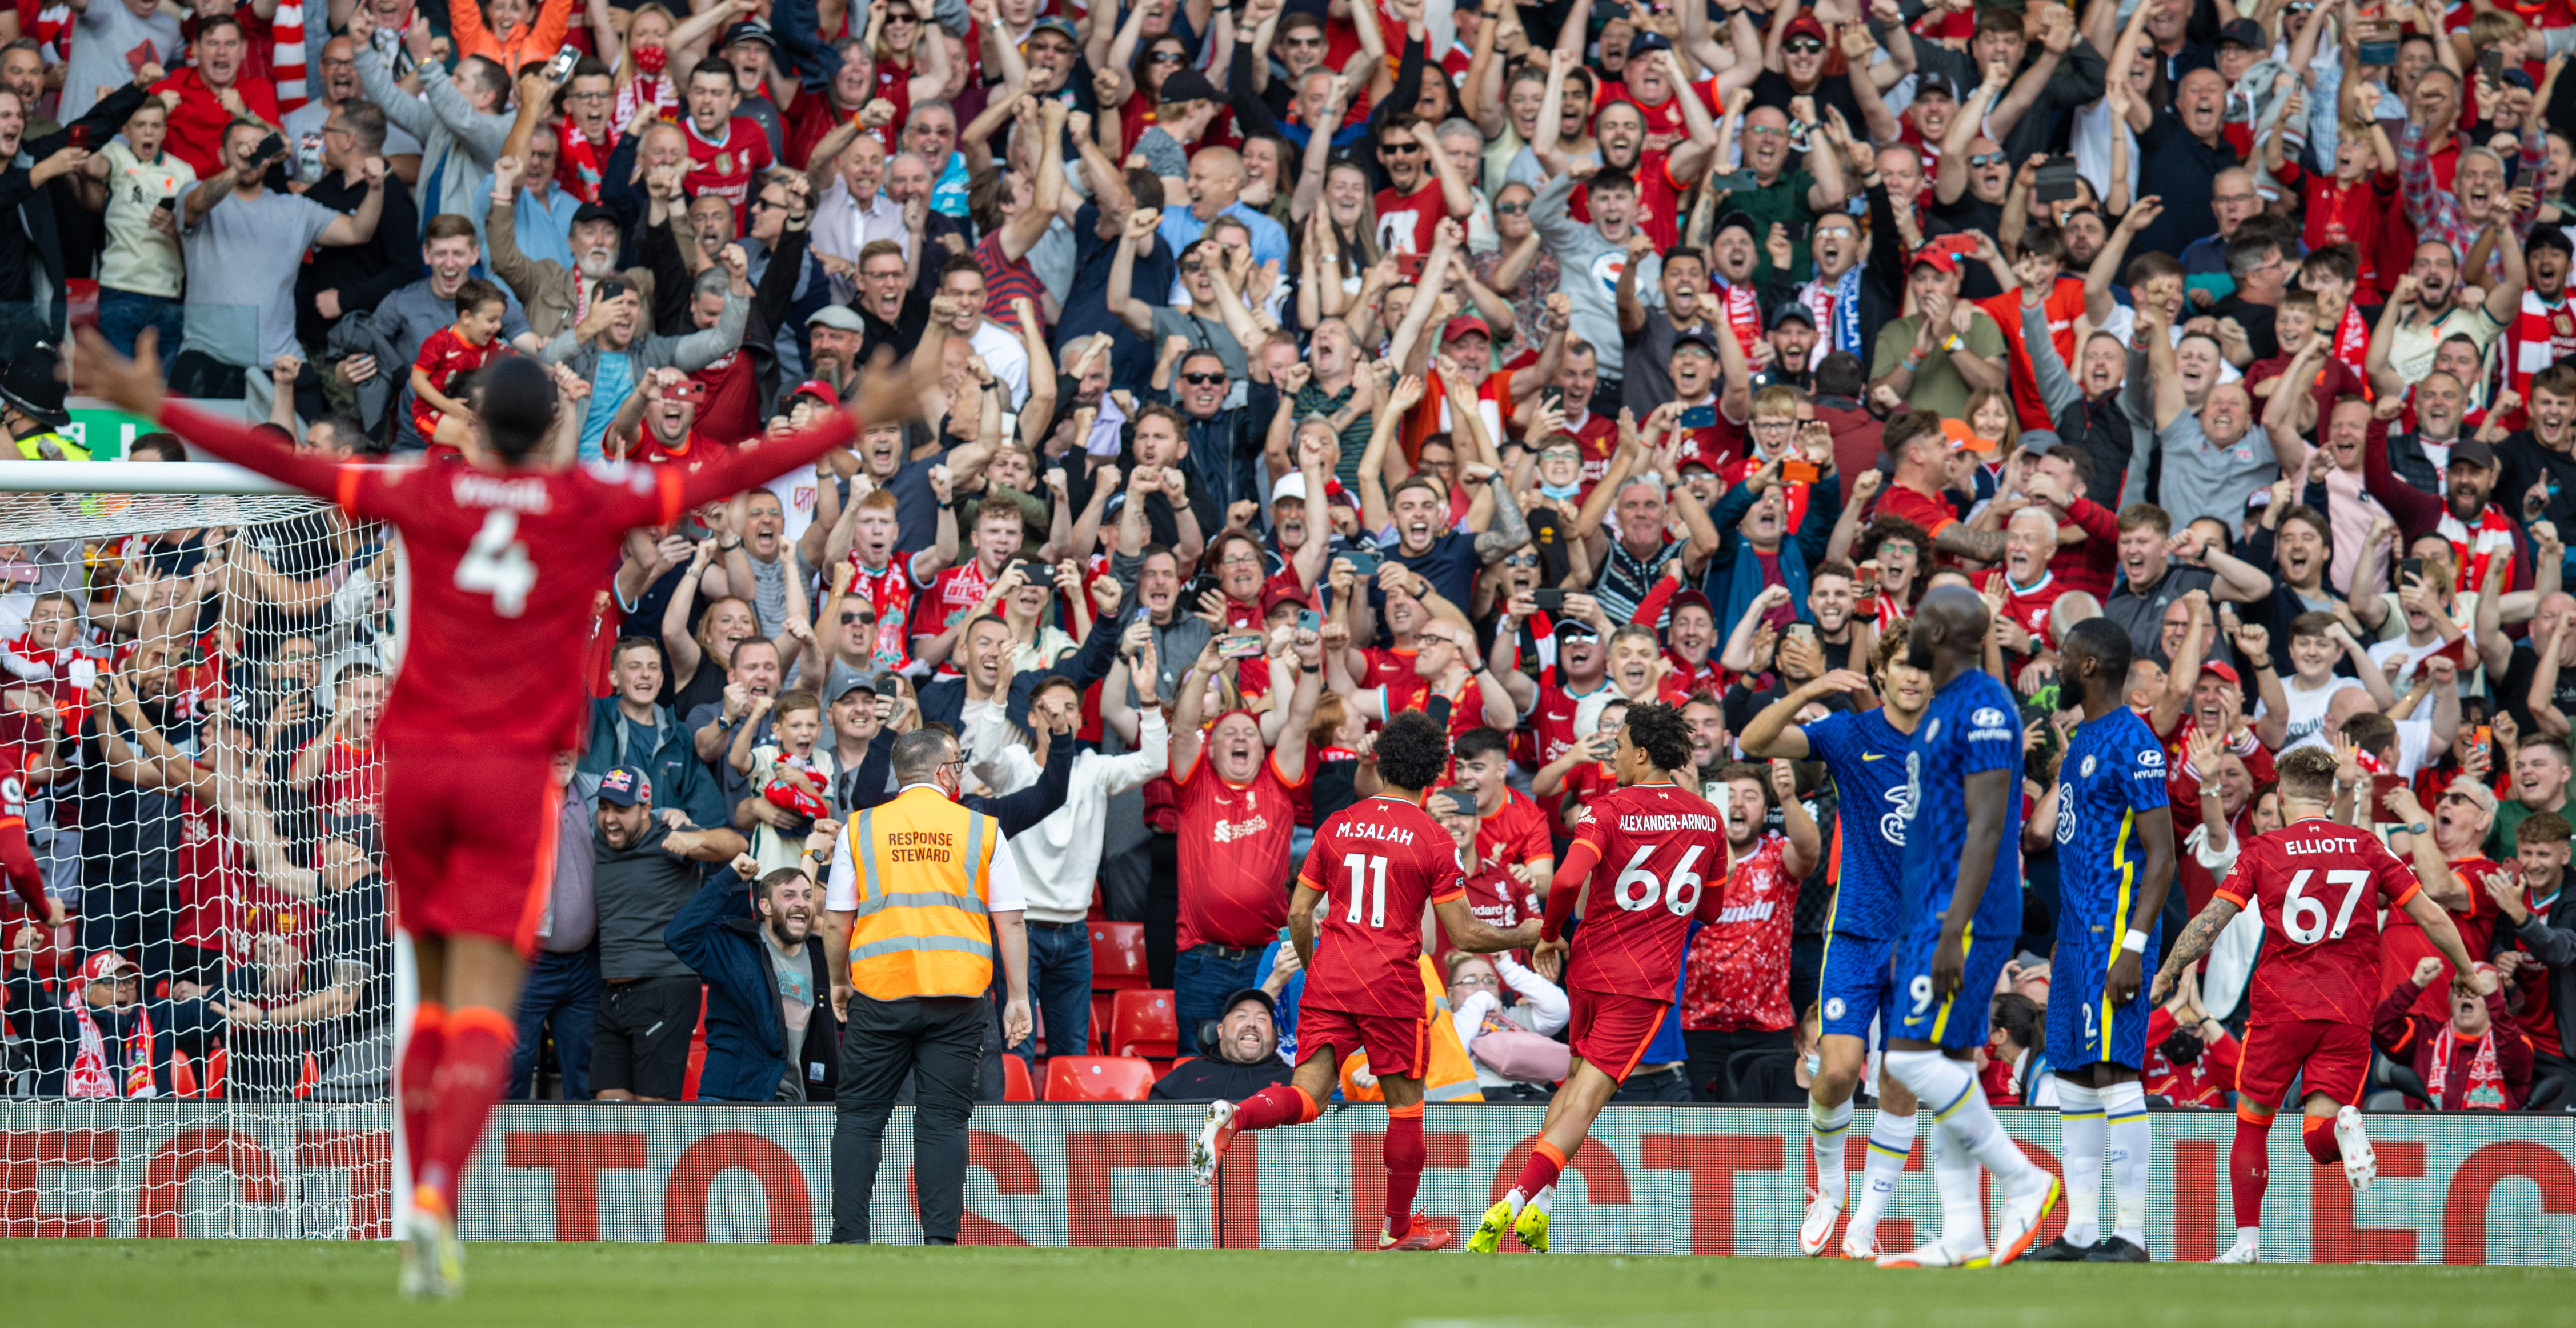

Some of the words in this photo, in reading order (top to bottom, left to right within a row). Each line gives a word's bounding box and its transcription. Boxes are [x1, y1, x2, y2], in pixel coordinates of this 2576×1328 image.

[454, 507, 539, 619] 4
[1336, 822, 1414, 846] M.SALAH
[1578, 814, 1596, 824] edia
[1619, 814, 1717, 833] ALEXANDER-ARNOLD
[888, 831, 953, 846] RESPONSE
[892, 847, 950, 862] STEWARD
[2285, 837, 2357, 855] ELLIOTT
[1343, 853, 1388, 928] 11
[1614, 845, 1705, 917] 66
[2282, 869, 2371, 945] 67
[1910, 975, 1933, 1015] 9
[2082, 1002, 2097, 1038] 2
[505, 1129, 812, 1243] TO
